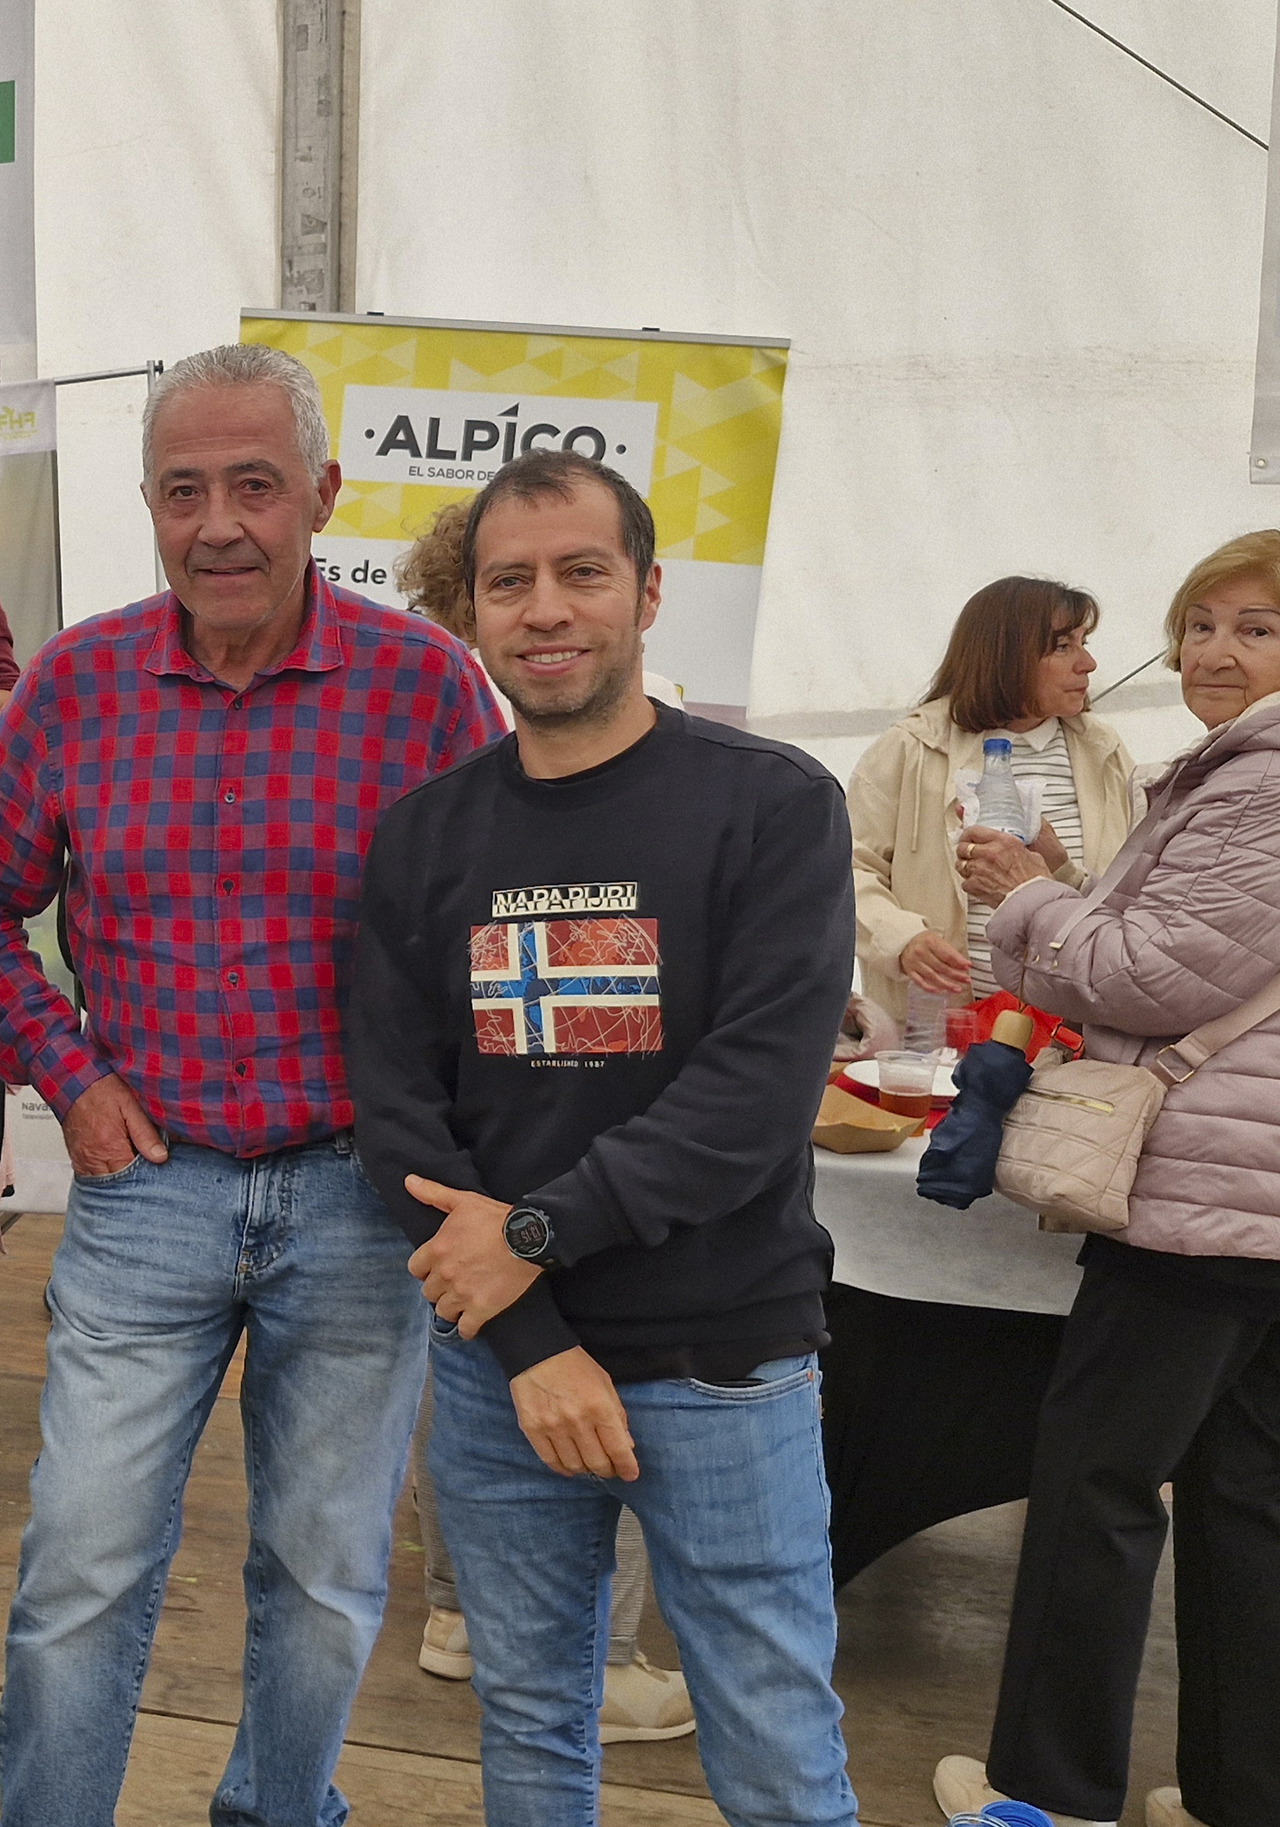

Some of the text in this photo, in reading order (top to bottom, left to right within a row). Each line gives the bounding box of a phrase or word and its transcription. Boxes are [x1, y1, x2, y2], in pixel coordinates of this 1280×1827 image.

[408, 466, 424, 477] EL
[427, 467, 475, 481] SABOR
[350, 559, 387, 585] de
[493, 883, 637, 915] NAPAPIJRI
